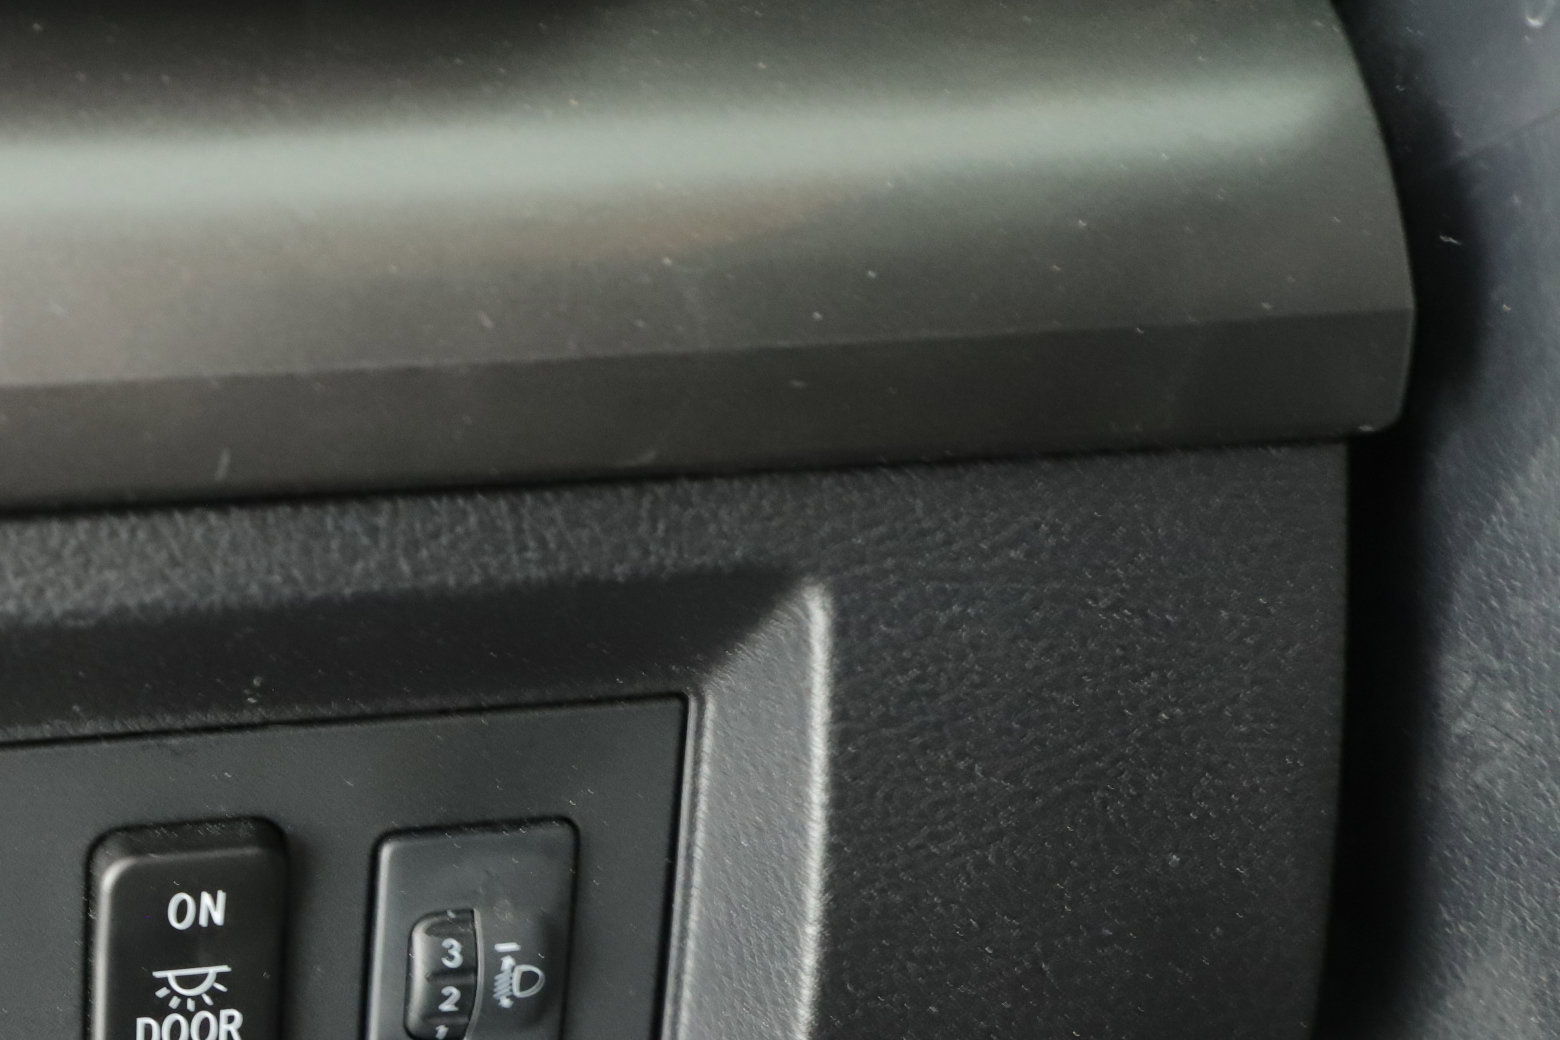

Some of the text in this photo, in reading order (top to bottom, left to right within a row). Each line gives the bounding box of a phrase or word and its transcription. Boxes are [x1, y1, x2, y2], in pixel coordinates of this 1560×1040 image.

[167, 890, 227, 930] ON
[441, 938, 463, 969] 3
[438, 985, 461, 1012] 2
